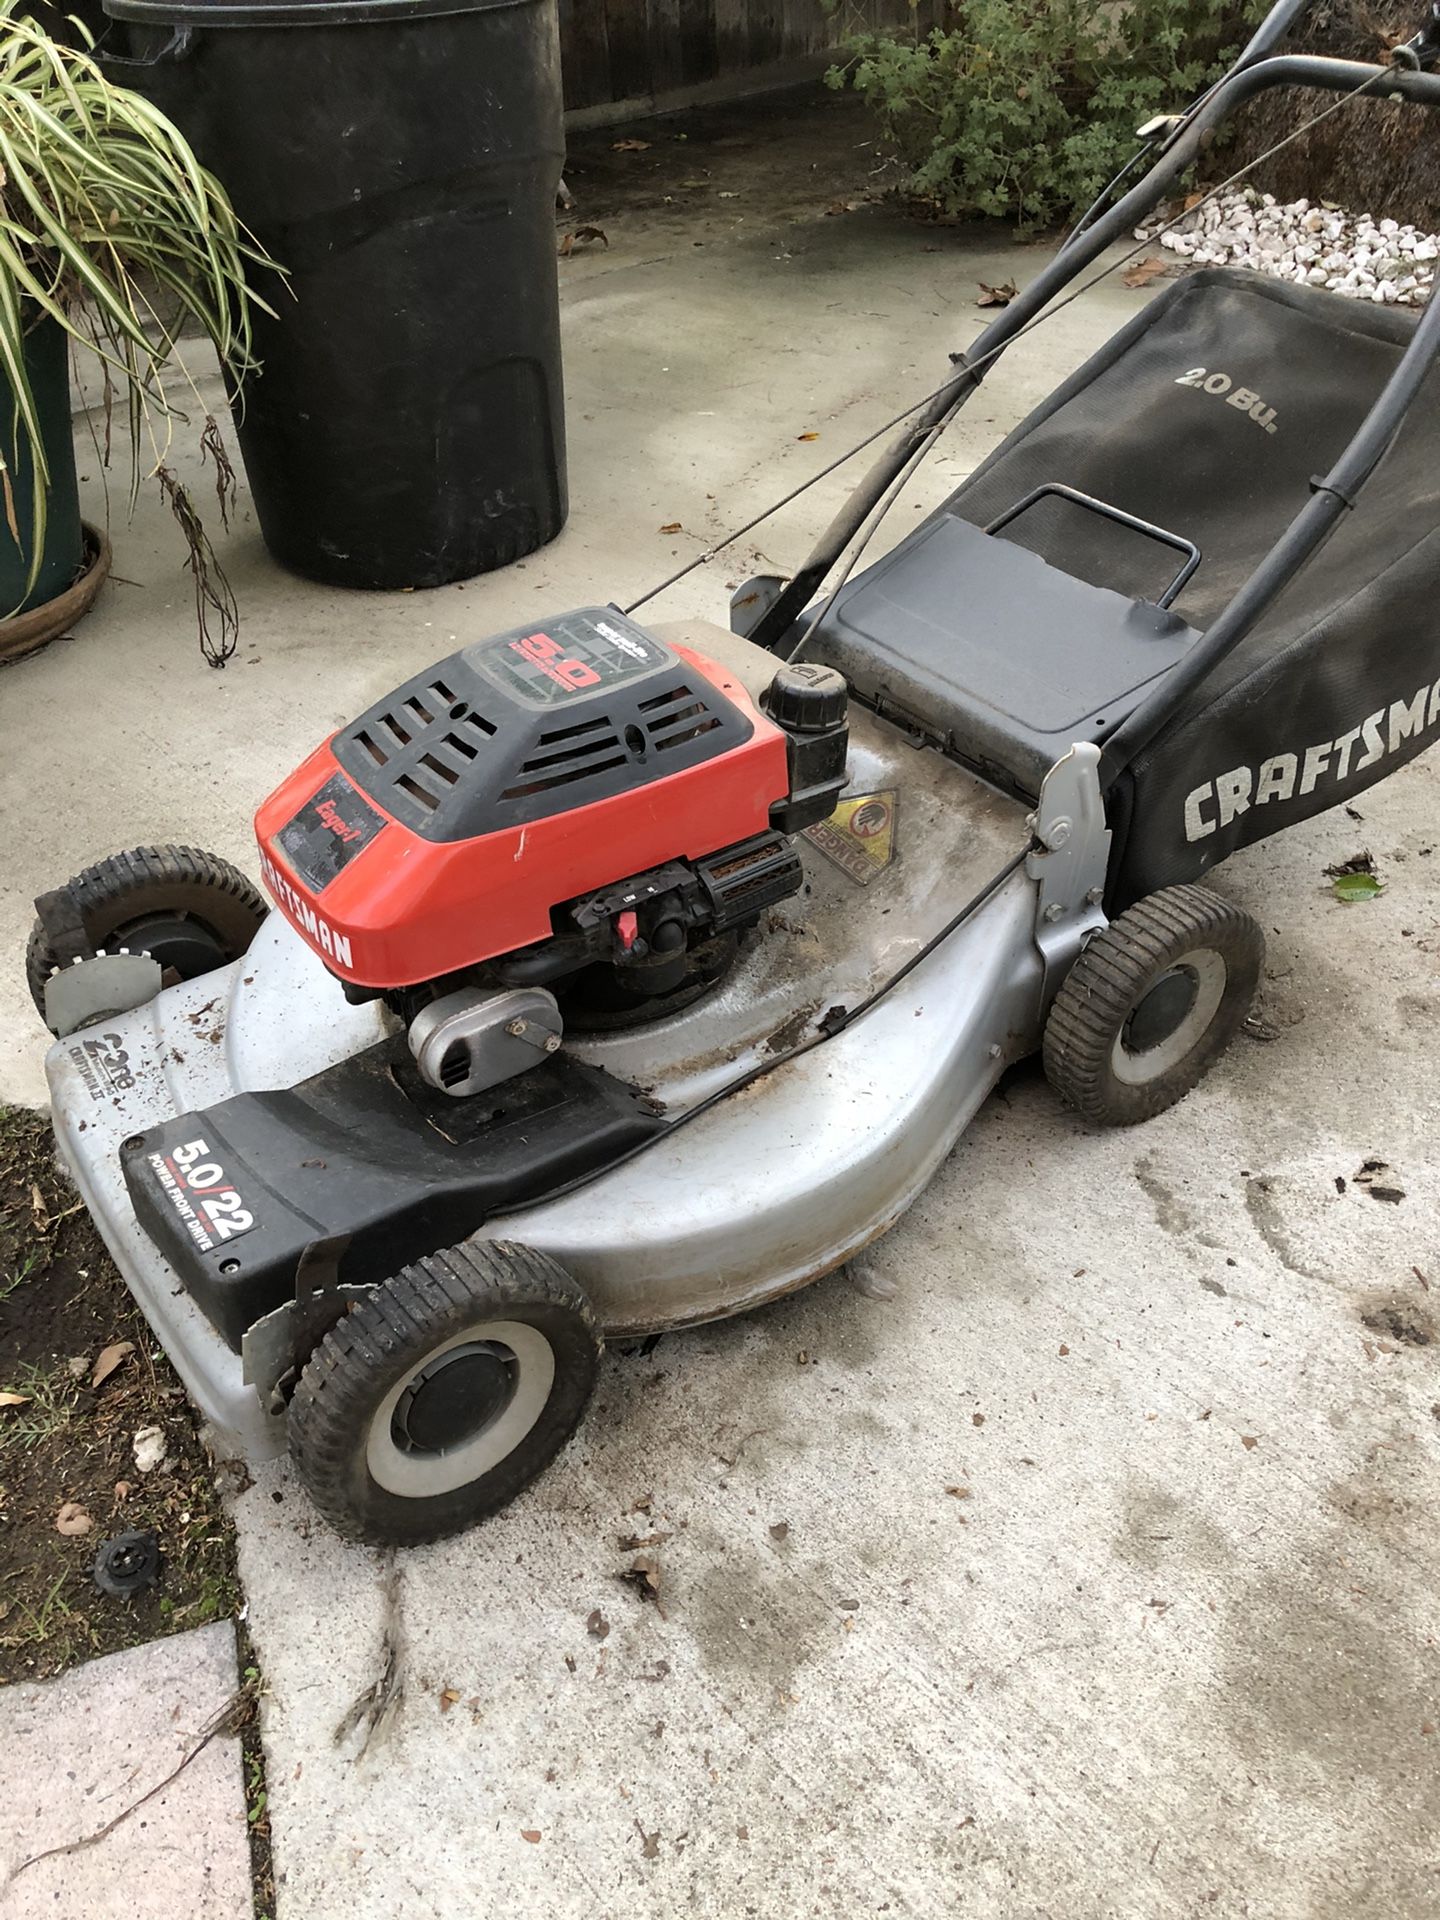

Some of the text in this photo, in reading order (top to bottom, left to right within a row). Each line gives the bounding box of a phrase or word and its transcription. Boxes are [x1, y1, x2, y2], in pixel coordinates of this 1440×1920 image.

[1173, 367, 1232, 395] 2.0
[520, 632, 601, 688] 5.0
[807, 822, 870, 875] DANGER
[258, 846, 353, 969] AFTSMAN
[147, 1153, 177, 1188] POWER
[168, 1187, 196, 1220] FRONT
[187, 1219, 214, 1251] DRIVE
[172, 1139, 254, 1239] 5.0/22
